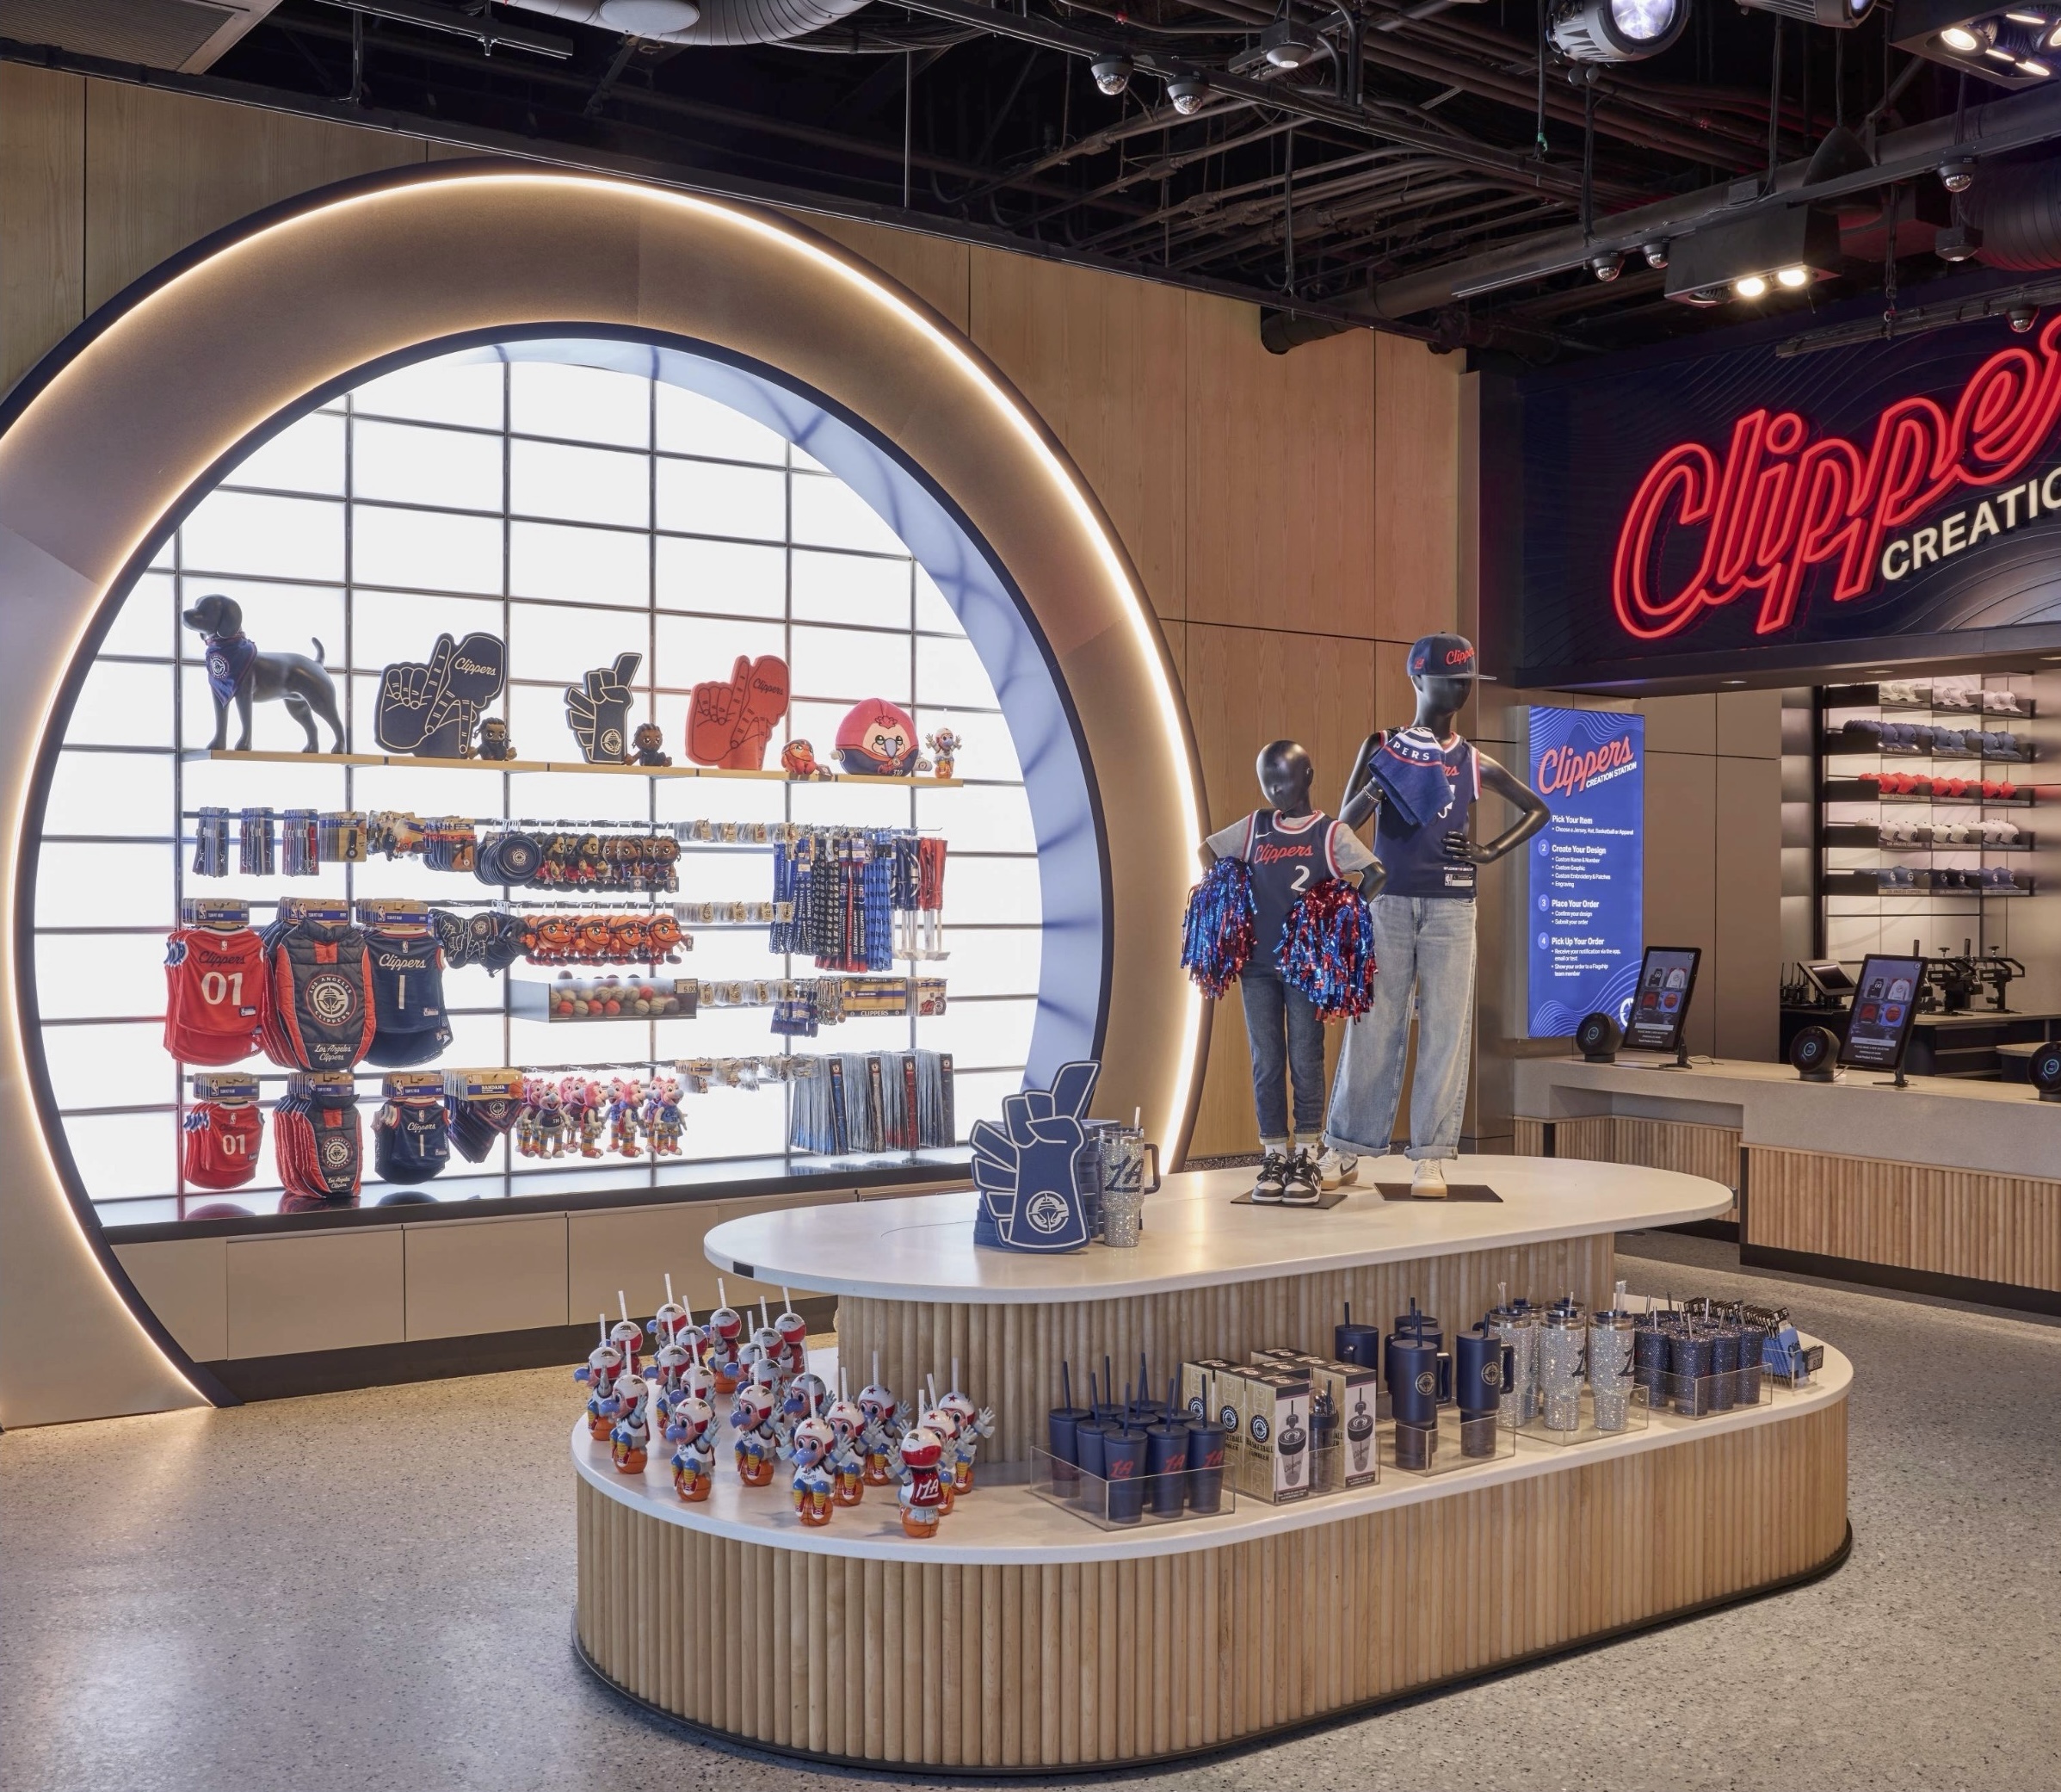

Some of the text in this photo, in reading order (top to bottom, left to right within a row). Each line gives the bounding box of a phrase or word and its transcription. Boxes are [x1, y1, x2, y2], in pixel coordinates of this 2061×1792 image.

[454, 657, 497, 676] Clippers
[753, 678, 783, 695] Clippers
[1538, 736, 1634, 797] Clippers
[1586, 761, 1637, 788] CREATION STATION
[1552, 814, 1593, 825] Pick Your Item
[1254, 843, 1313, 865] Clippers
[1586, 846, 1607, 856] Design
[1291, 864, 1310, 893] 2
[1541, 899, 1546, 907] 3
[1564, 937, 1573, 947] Up
[199, 950, 245, 967] Clippers
[379, 954, 427, 971] Clippers
[201, 972, 243, 1005] 01
[309, 977, 352, 993] LOS ANGELES
[398, 974, 405, 1010] 1
[315, 1011, 350, 1023] CLIPPERS
[319, 1053, 344, 1061] Clippers
[327, 1044, 351, 1054] Angeles
[407, 1122, 436, 1133] Clippers
[223, 1134, 245, 1155] 01
[419, 1134, 424, 1157] 1
[1105, 1154, 1144, 1193] LA
[1225, 1434, 1243, 1443] ETBALL
[1246, 1437, 1273, 1453] BASKETBALL
[1162, 1454, 1186, 1474] LA
[1203, 1449, 1223, 1468] LA
[1110, 1460, 1134, 1479] LA
